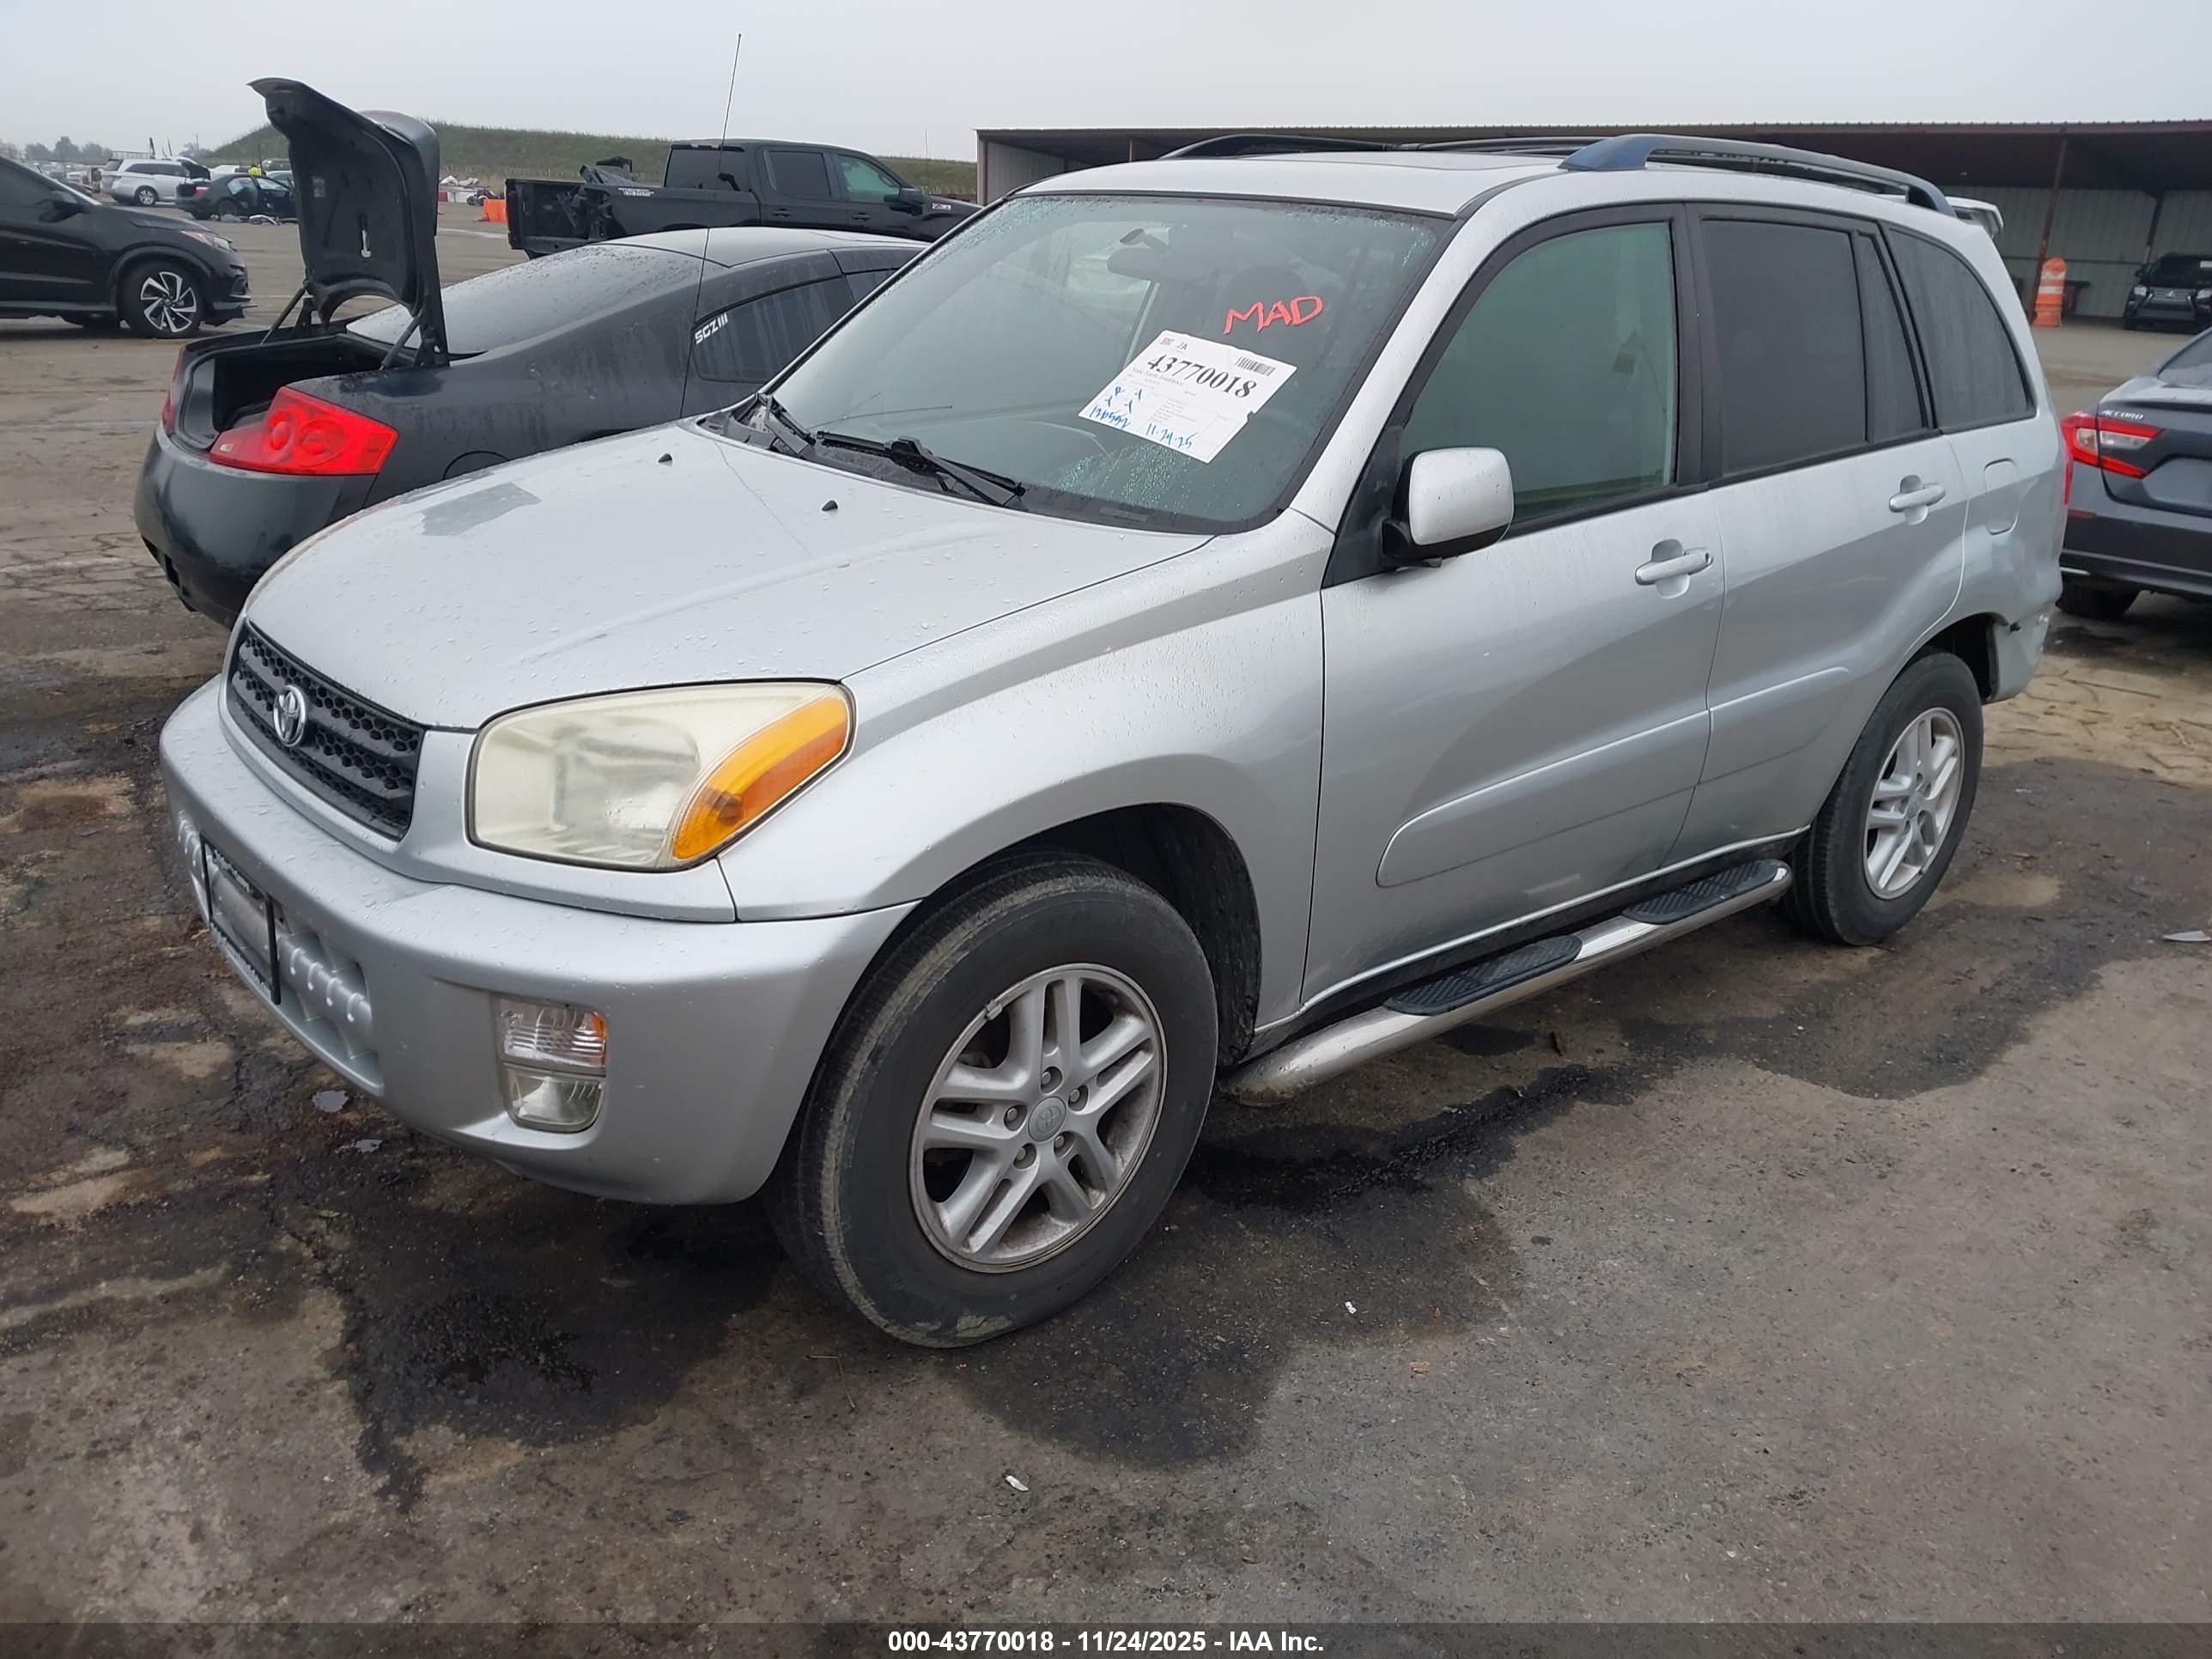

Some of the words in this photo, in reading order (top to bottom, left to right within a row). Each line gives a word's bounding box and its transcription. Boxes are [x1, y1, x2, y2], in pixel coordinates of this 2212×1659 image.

[1224, 295, 1323, 334] MAD
[1147, 354, 1257, 398] 43770018
[2101, 410, 2144, 420] ACCORD
